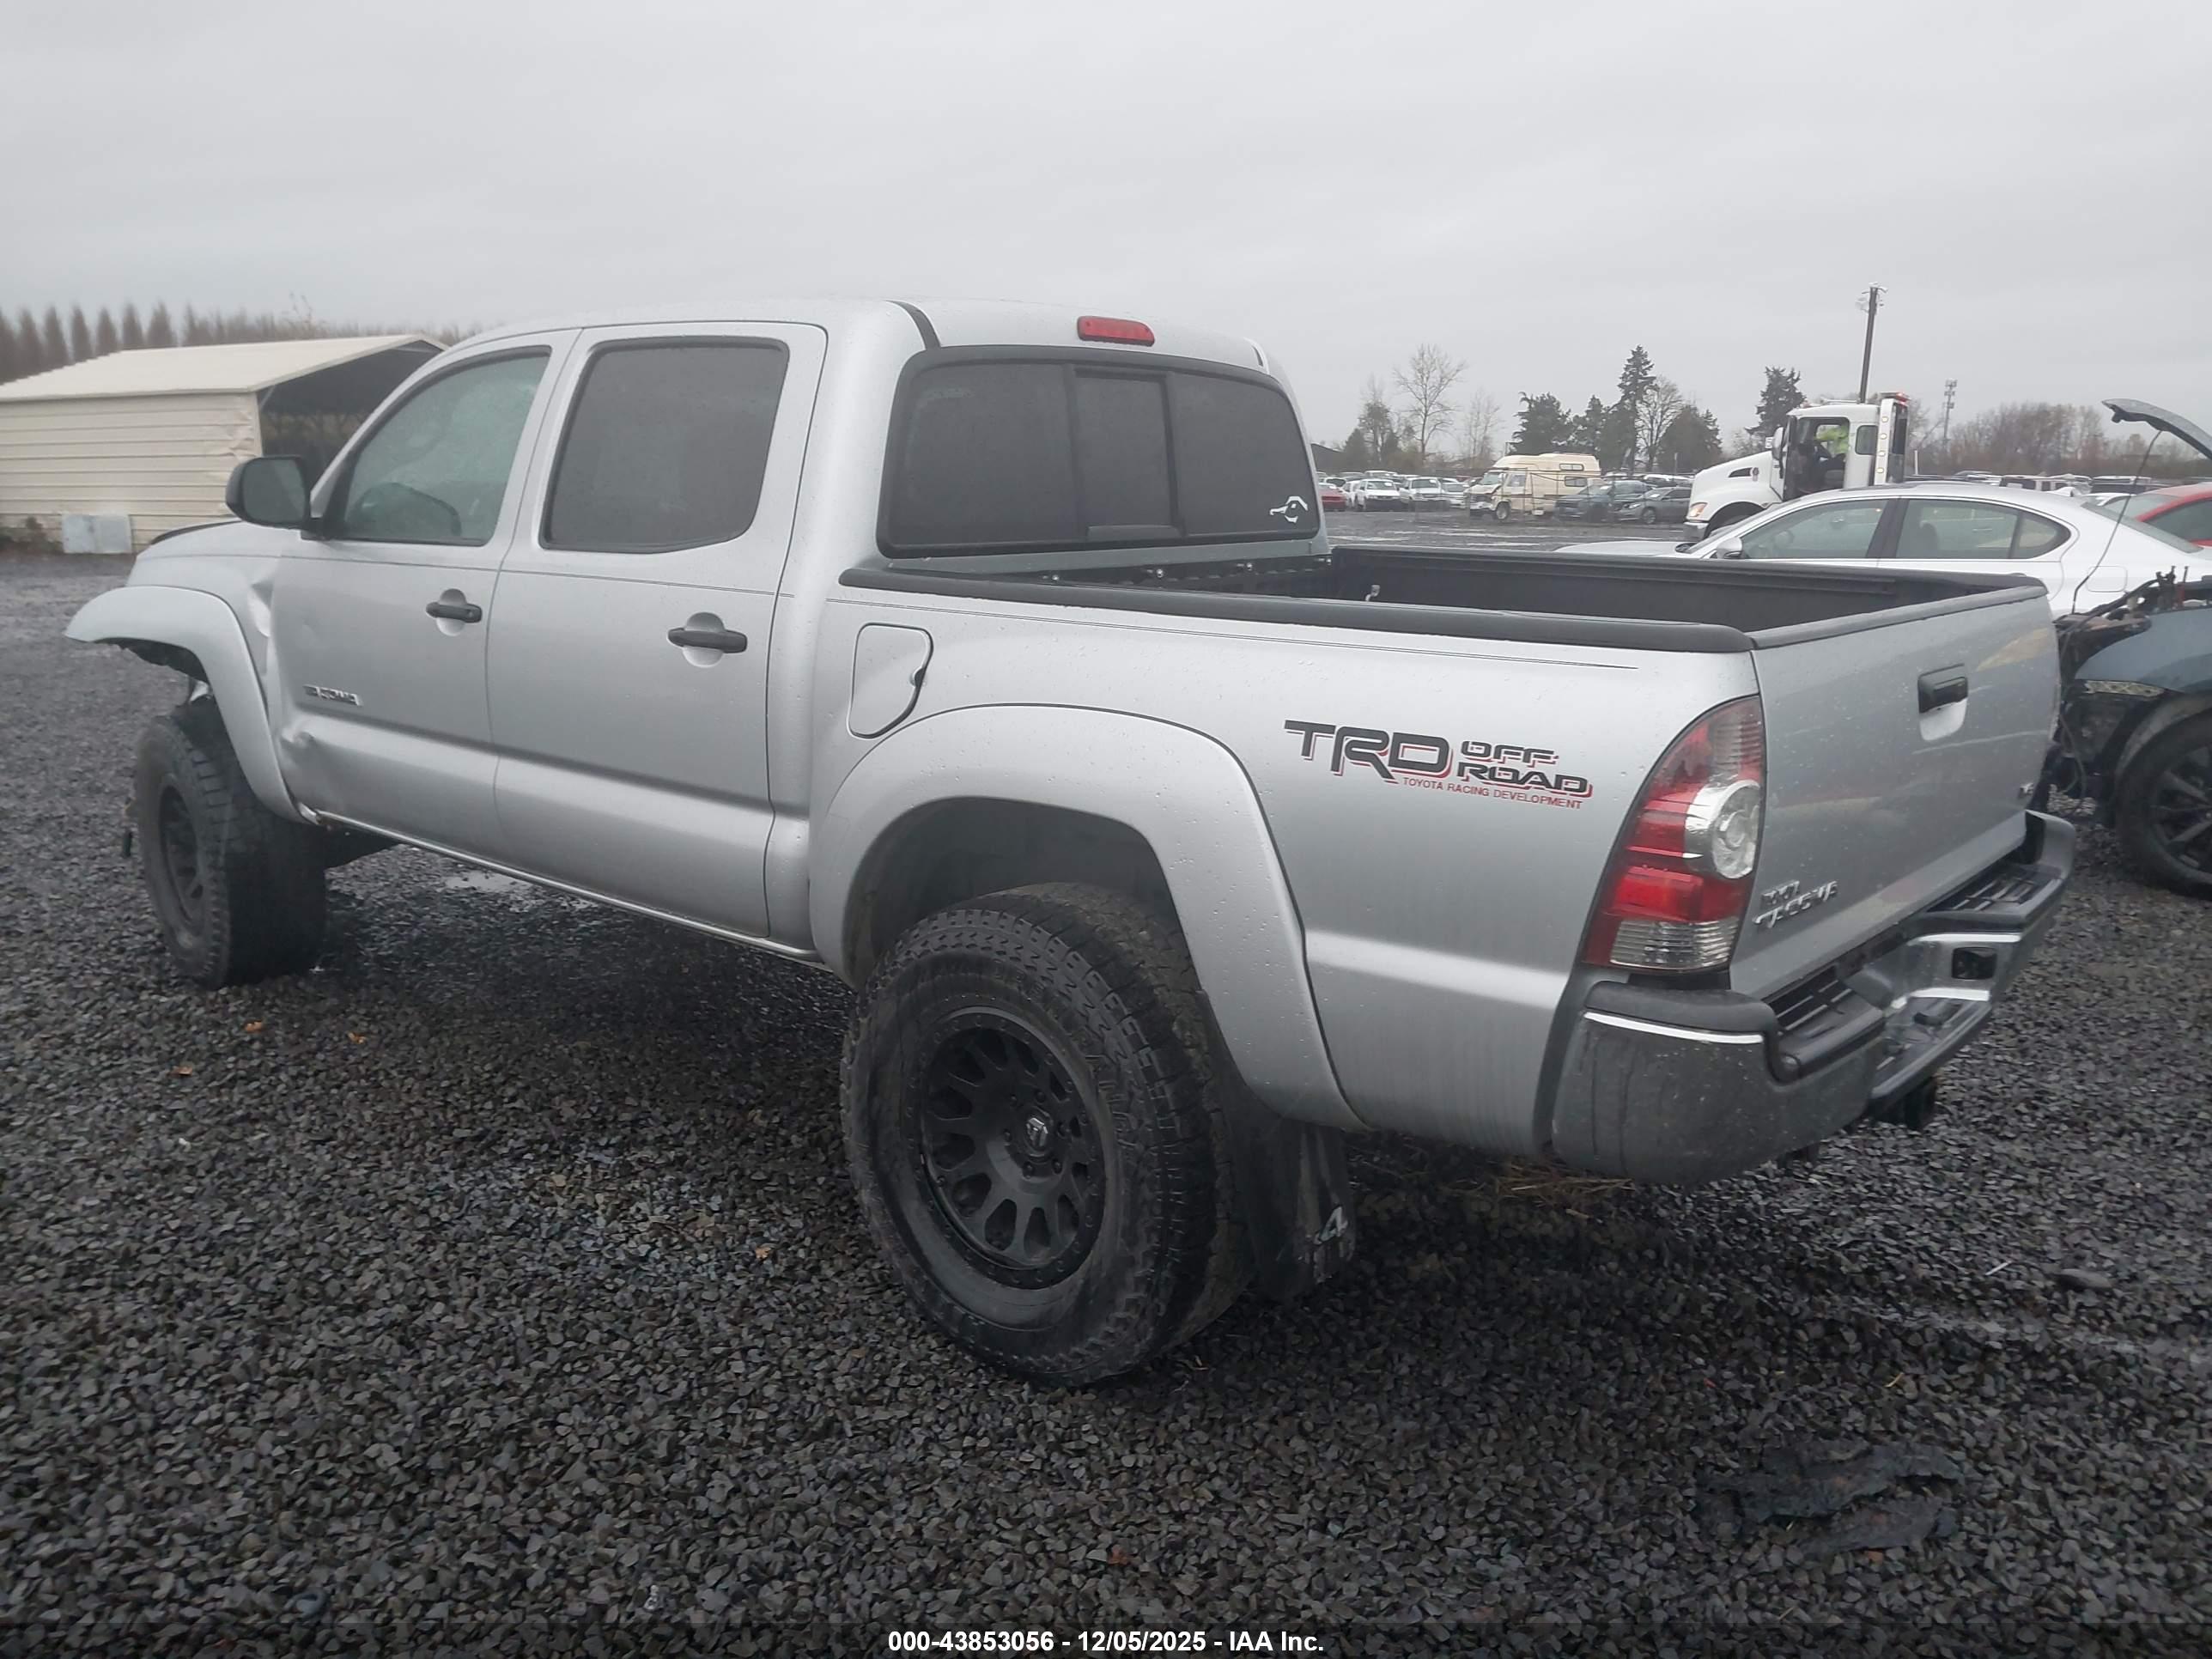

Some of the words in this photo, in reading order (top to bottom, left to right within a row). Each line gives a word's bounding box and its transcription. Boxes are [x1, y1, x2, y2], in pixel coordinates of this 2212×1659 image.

[1284, 720, 1454, 784] TRD
[1460, 740, 1559, 767] OFF
[1403, 776, 1443, 791] TOYOTA
[1447, 782, 1490, 798] RACING
[1493, 788, 1583, 810] DEVELOPMENT
[1456, 761, 1594, 798] ROAD
